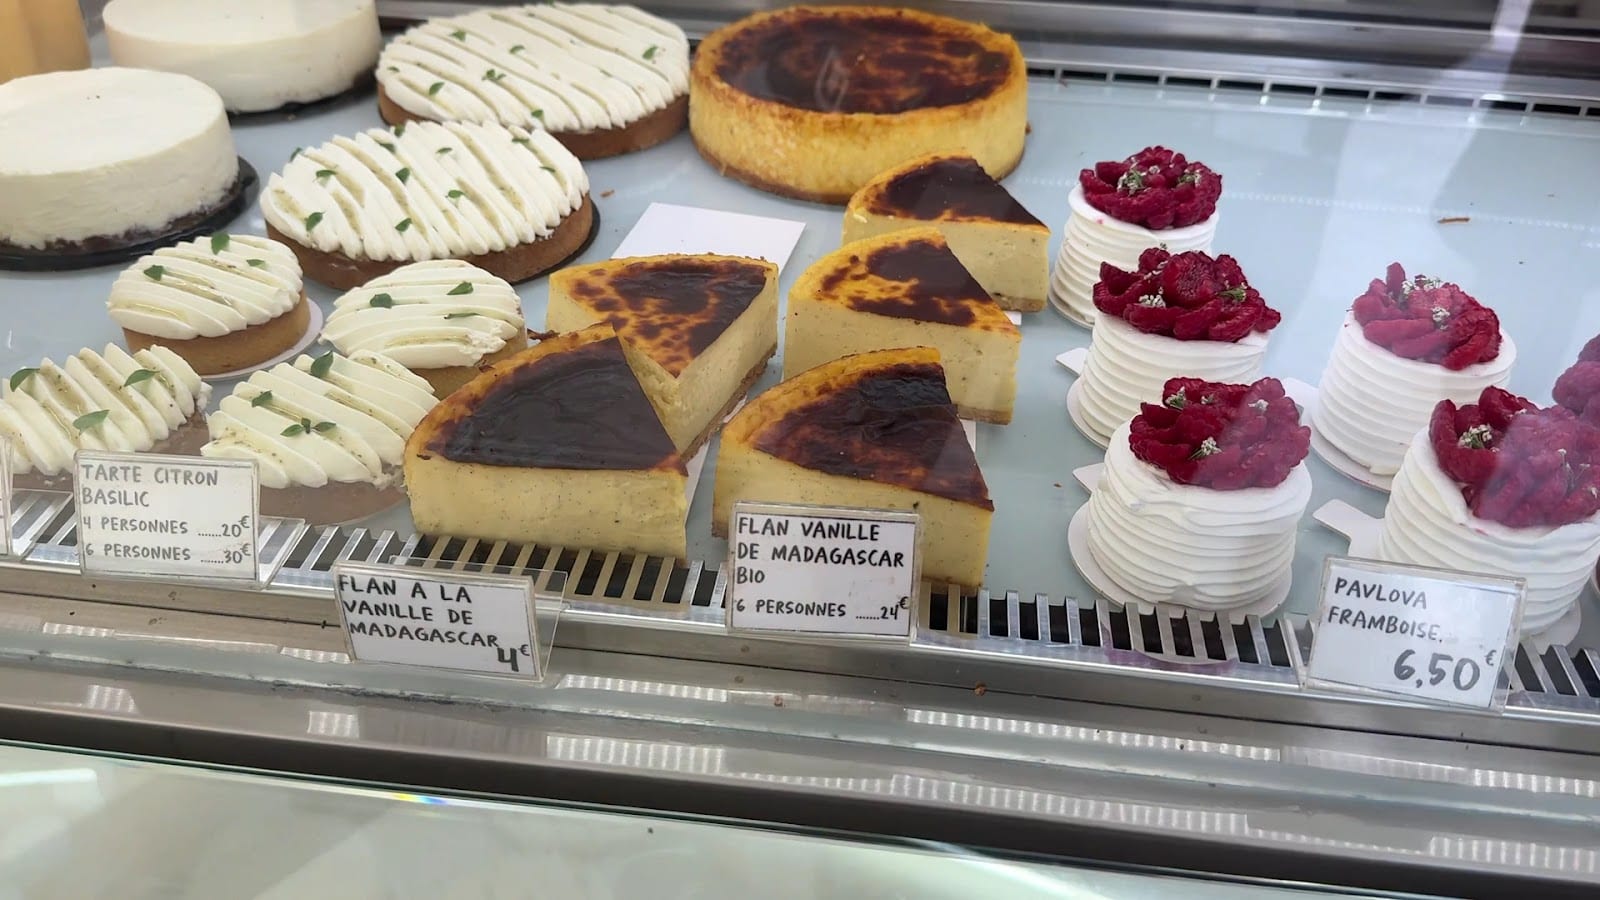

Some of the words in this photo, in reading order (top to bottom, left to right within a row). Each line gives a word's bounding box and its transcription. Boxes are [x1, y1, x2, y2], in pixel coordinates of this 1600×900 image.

[81, 463, 142, 483] TARTE
[153, 466, 218, 486] CITRON
[81, 486, 150, 507] BASILIC
[82, 516, 92, 530] 4
[100, 517, 189, 534] PERSONNES
[738, 517, 789, 536] FLAN
[801, 521, 880, 541] VANILLE
[85, 543, 94, 556] 6
[103, 543, 192, 561] PERSONNES
[737, 542, 760, 560] DE
[771, 545, 904, 568] MADAGASCAR
[736, 566, 765, 584] BIO
[338, 575, 397, 596] FLAN
[411, 582, 427, 599] A
[440, 584, 472, 604] LA
[1334, 577, 1427, 609] PAVLOVA
[343, 600, 433, 622] VANILLE
[448, 608, 473, 625] DE
[736, 599, 745, 612] 6
[756, 599, 846, 617] PERSONNES
[349, 622, 499, 648] MADAGASCAR
